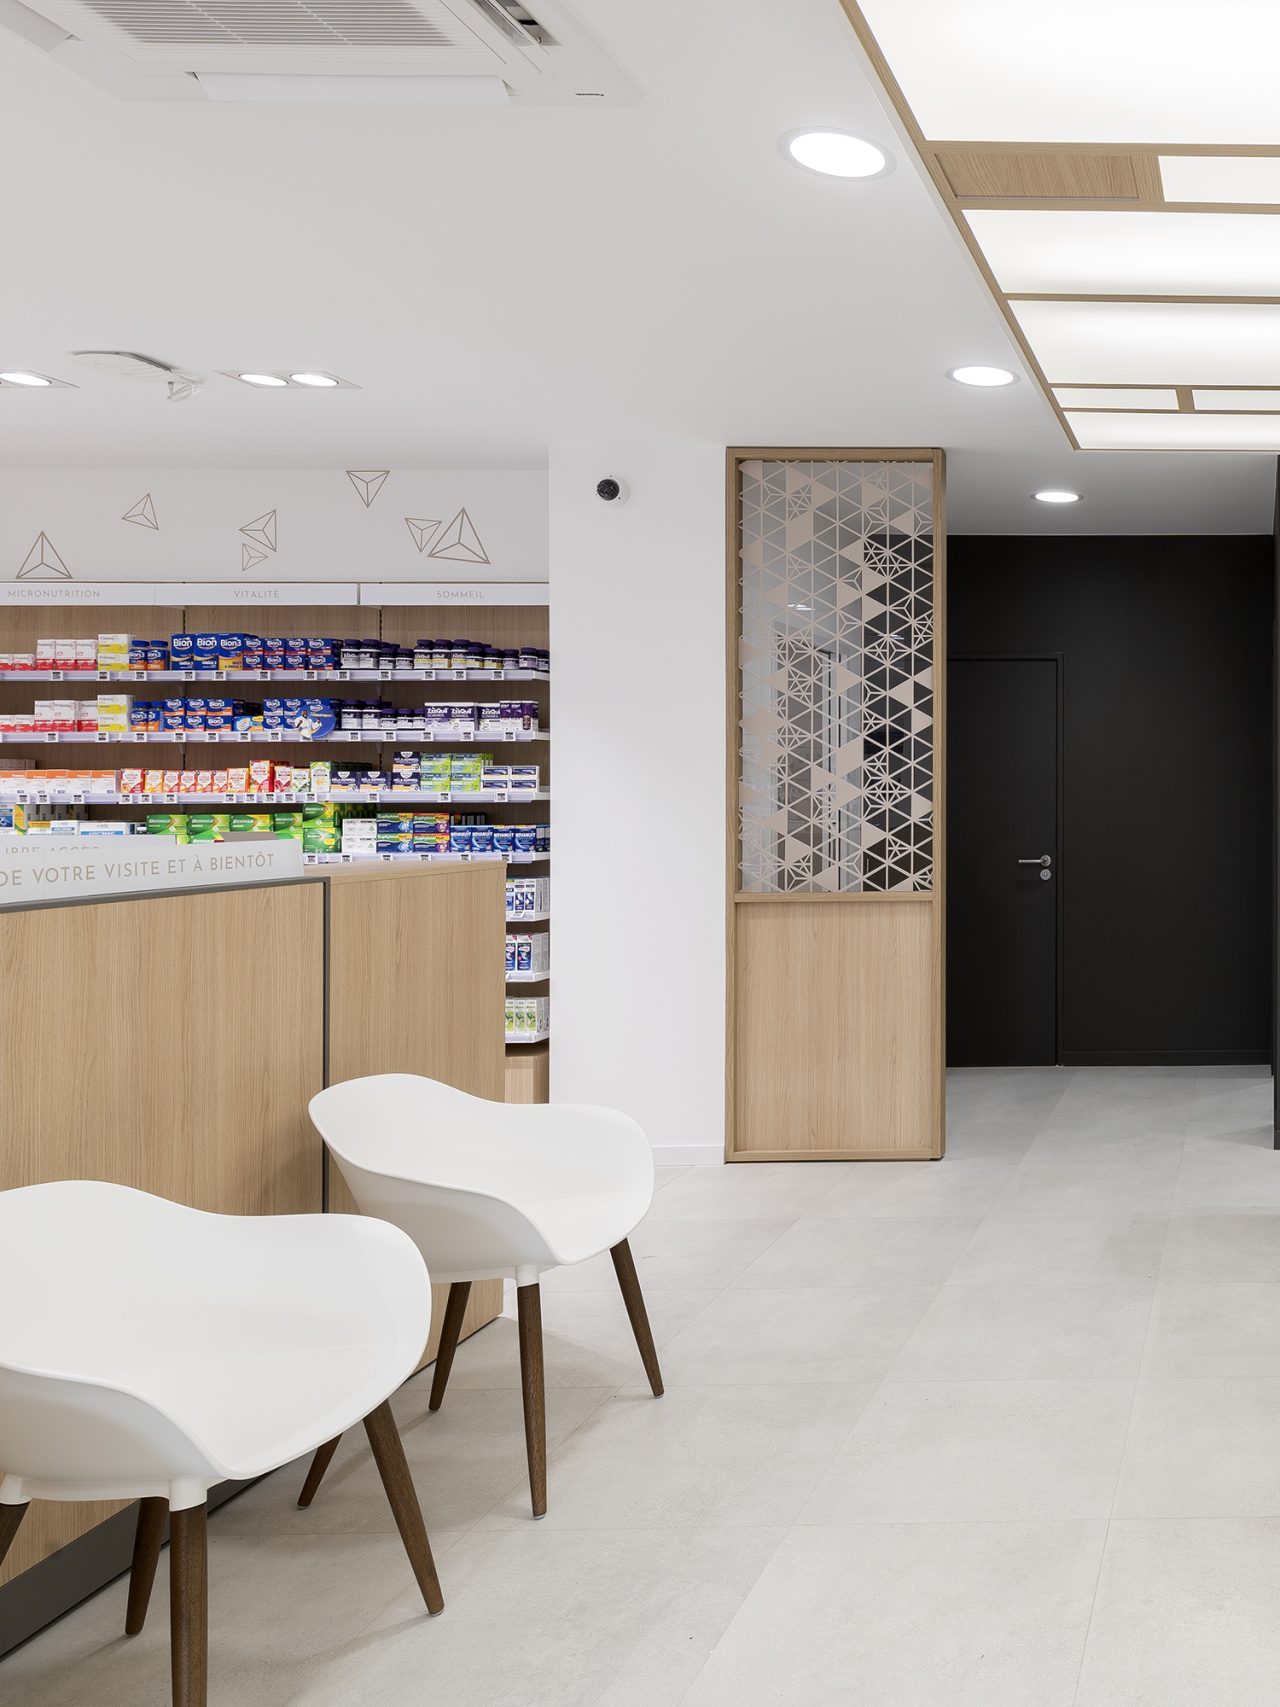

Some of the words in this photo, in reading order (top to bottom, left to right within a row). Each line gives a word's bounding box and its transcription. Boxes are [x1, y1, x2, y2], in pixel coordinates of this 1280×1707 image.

[8, 590, 101, 598] MICRONUTRITION
[436, 590, 484, 599] SOMMEIL
[32, 865, 96, 883] VOTRE
[104, 861, 160, 878] VISITE
[168, 859, 186, 874] ET
[193, 855, 203, 872] À
[210, 851, 274, 871] BIENTÔT
